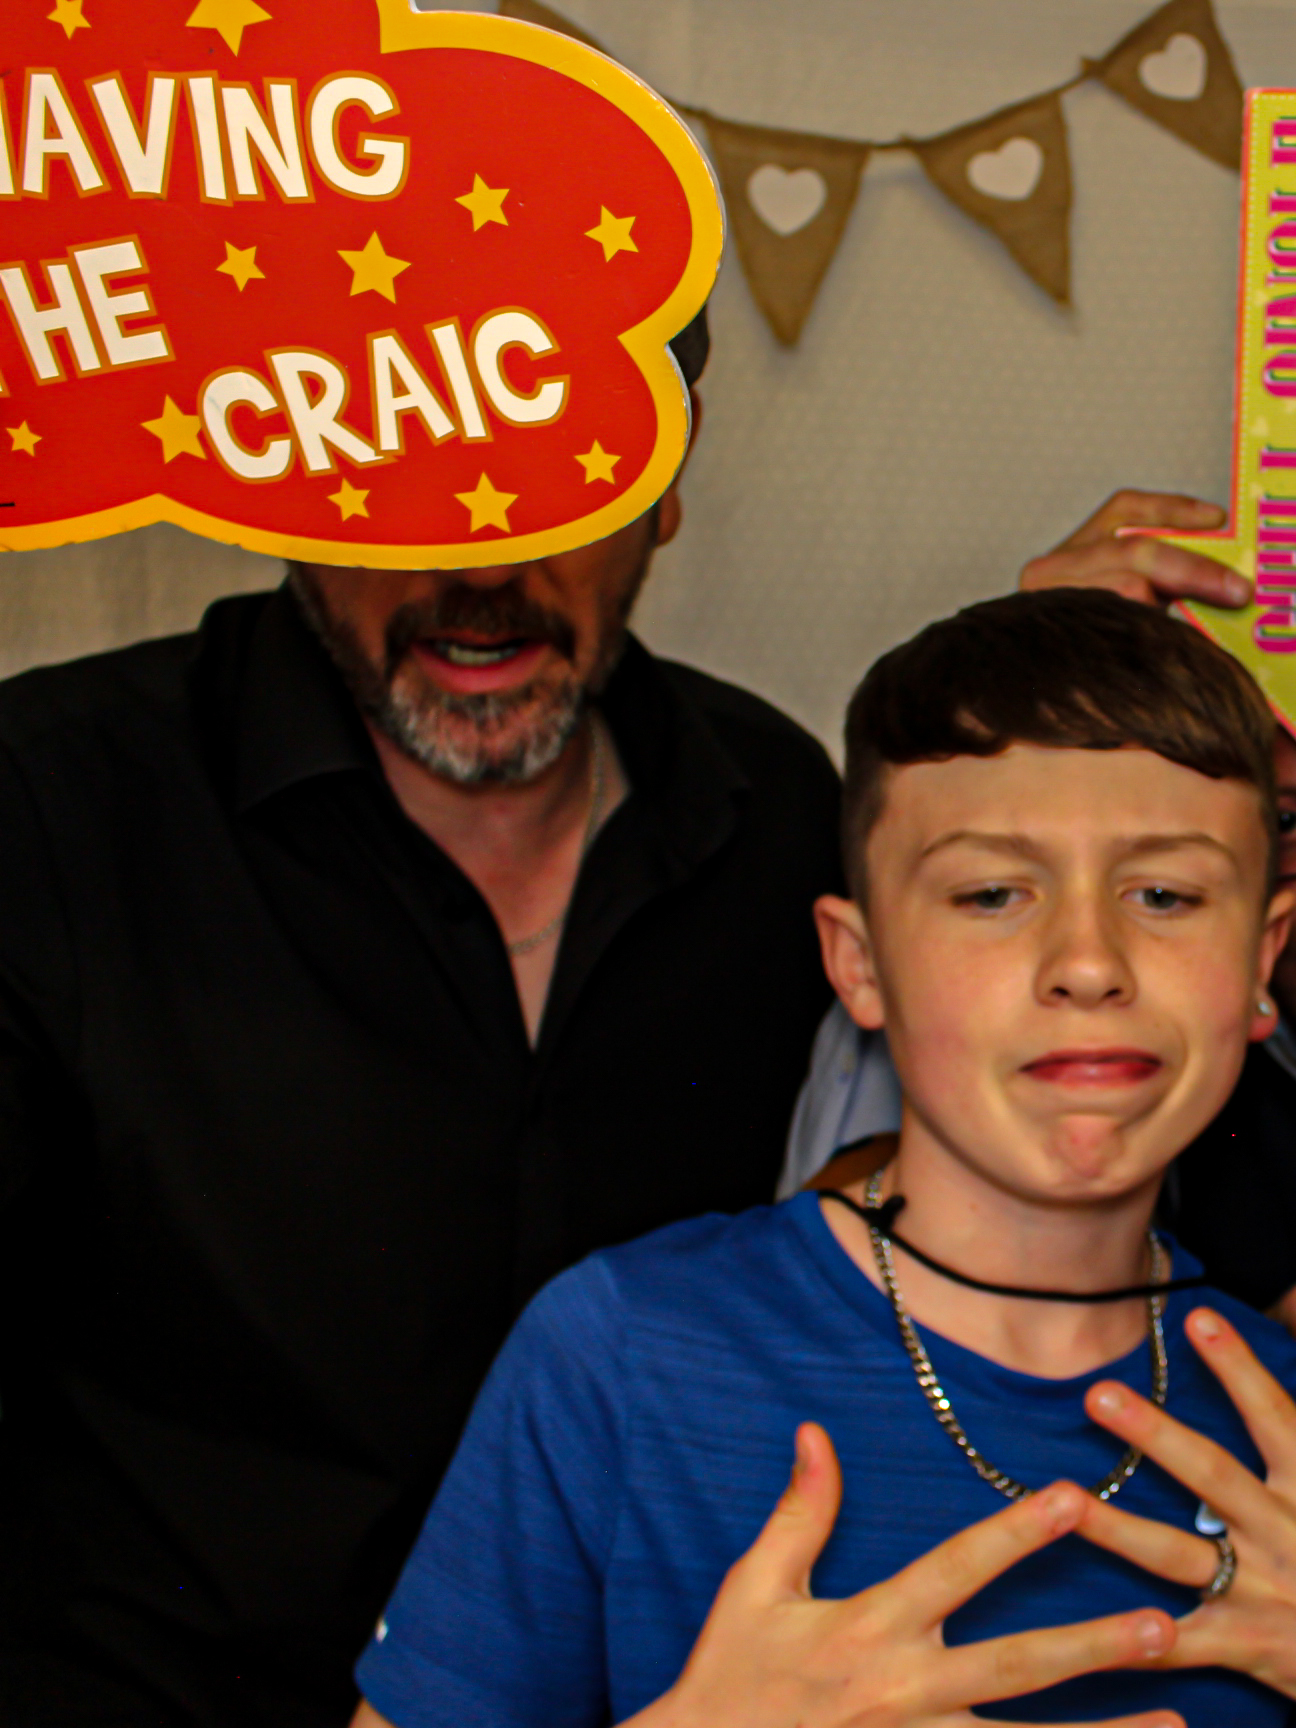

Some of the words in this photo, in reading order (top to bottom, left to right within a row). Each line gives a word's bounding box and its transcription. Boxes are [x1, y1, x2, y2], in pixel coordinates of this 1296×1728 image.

[0, 71, 407, 201] AVING
[0, 239, 169, 394] HE
[202, 310, 566, 480] CRAIC
